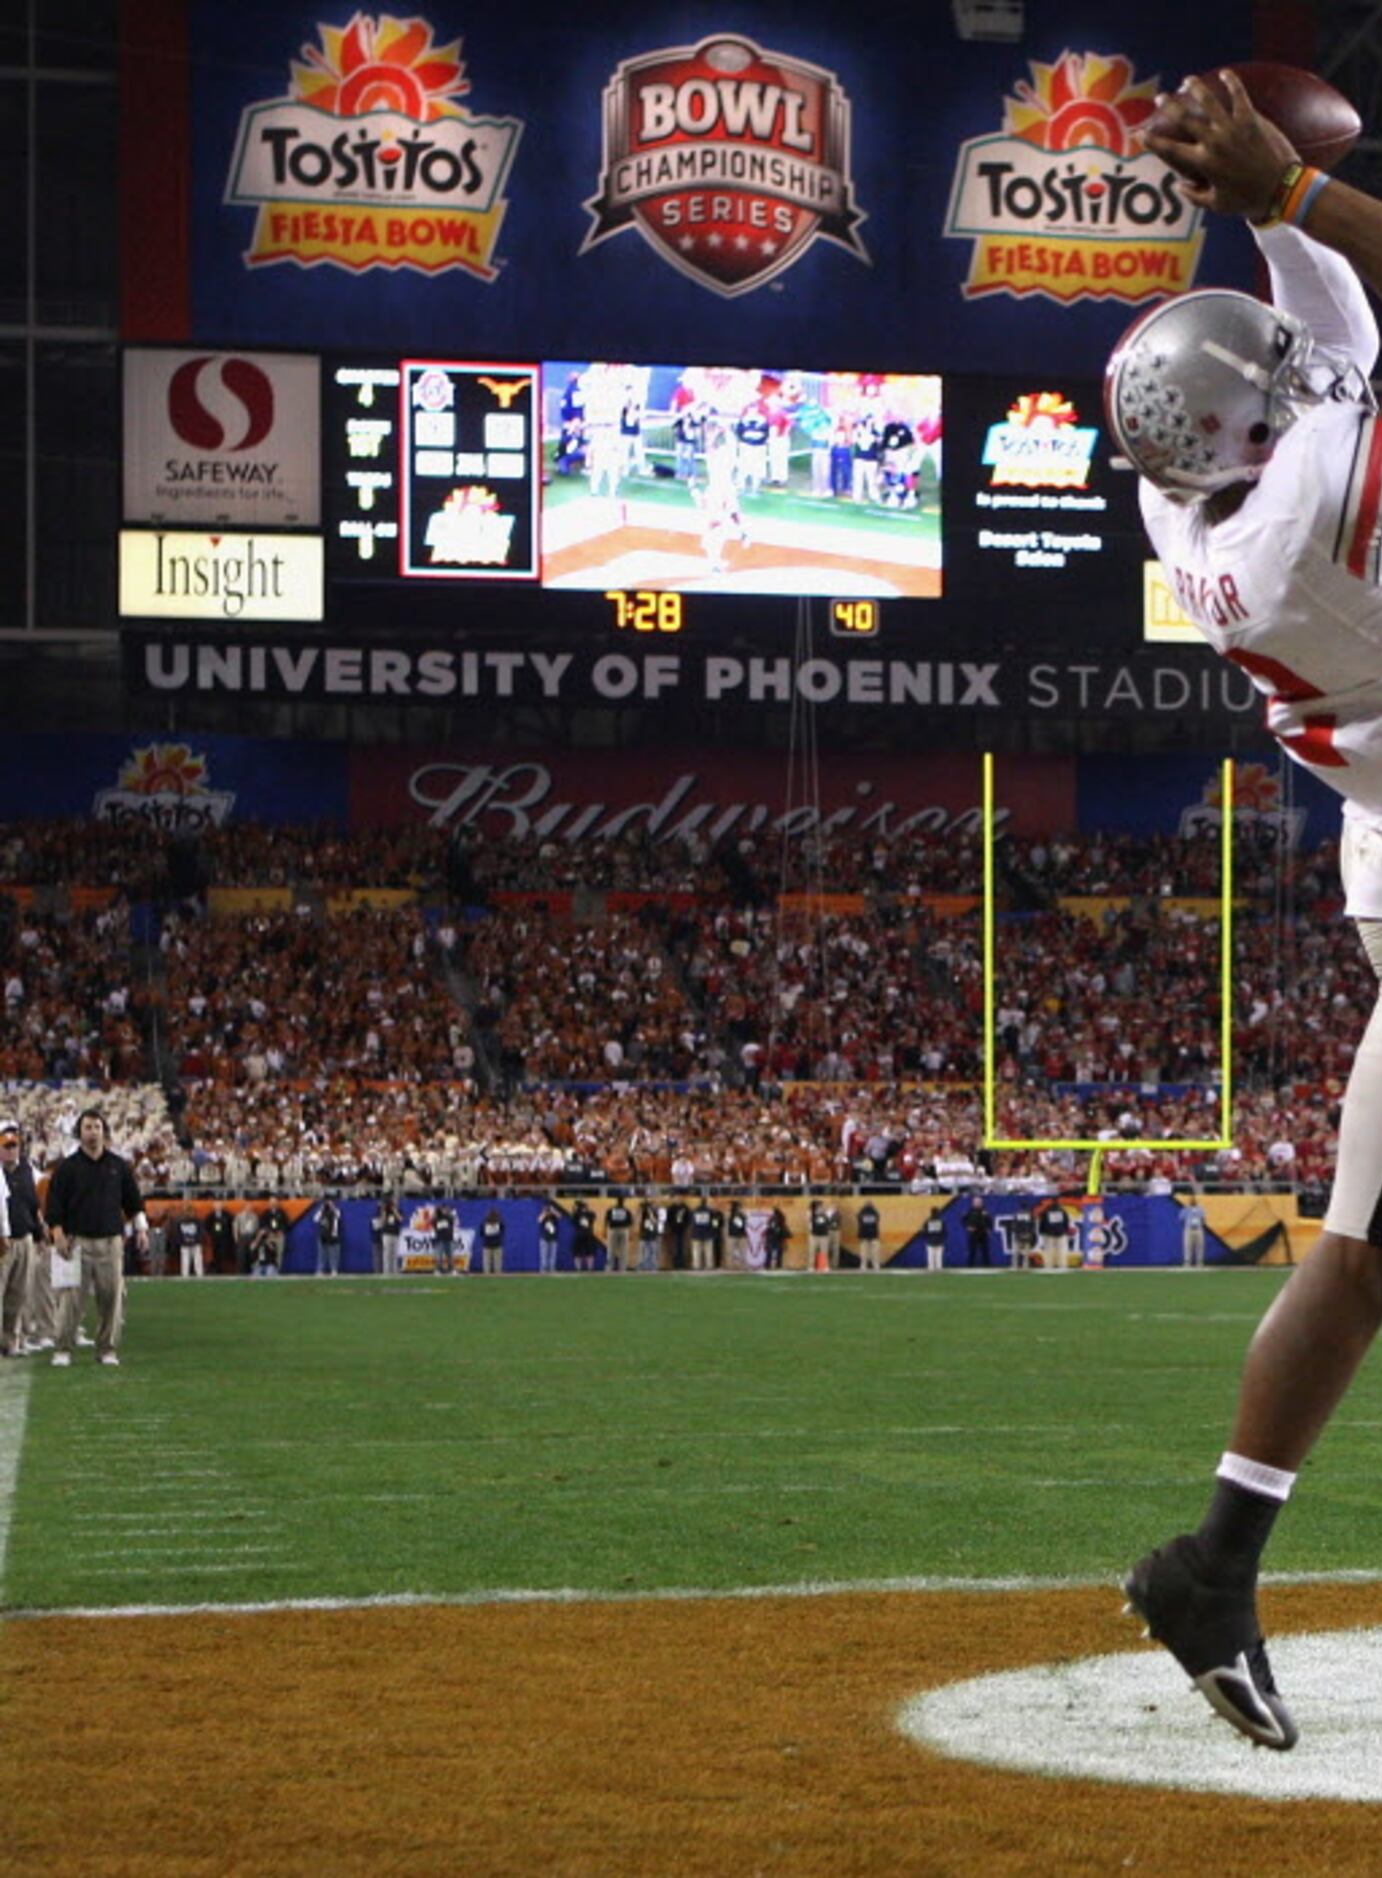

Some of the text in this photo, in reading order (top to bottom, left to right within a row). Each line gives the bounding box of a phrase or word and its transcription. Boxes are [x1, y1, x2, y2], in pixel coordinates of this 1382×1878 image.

[640, 83, 815, 148] BOWL
[616, 144, 832, 199] CHAMPIONSHIP
[270, 214, 481, 255] FIESTA BOWL
[662, 197, 794, 233] SERIES
[986, 246, 1183, 281] FIESTA BOWL
[165, 459, 278, 484] SAFEWAY
[153, 534, 285, 617] Insight
[605, 590, 682, 632] 7:28
[834, 602, 874, 631] 40
[145, 643, 1256, 711] UNIVERSITY OF PHOENIX STADIU
